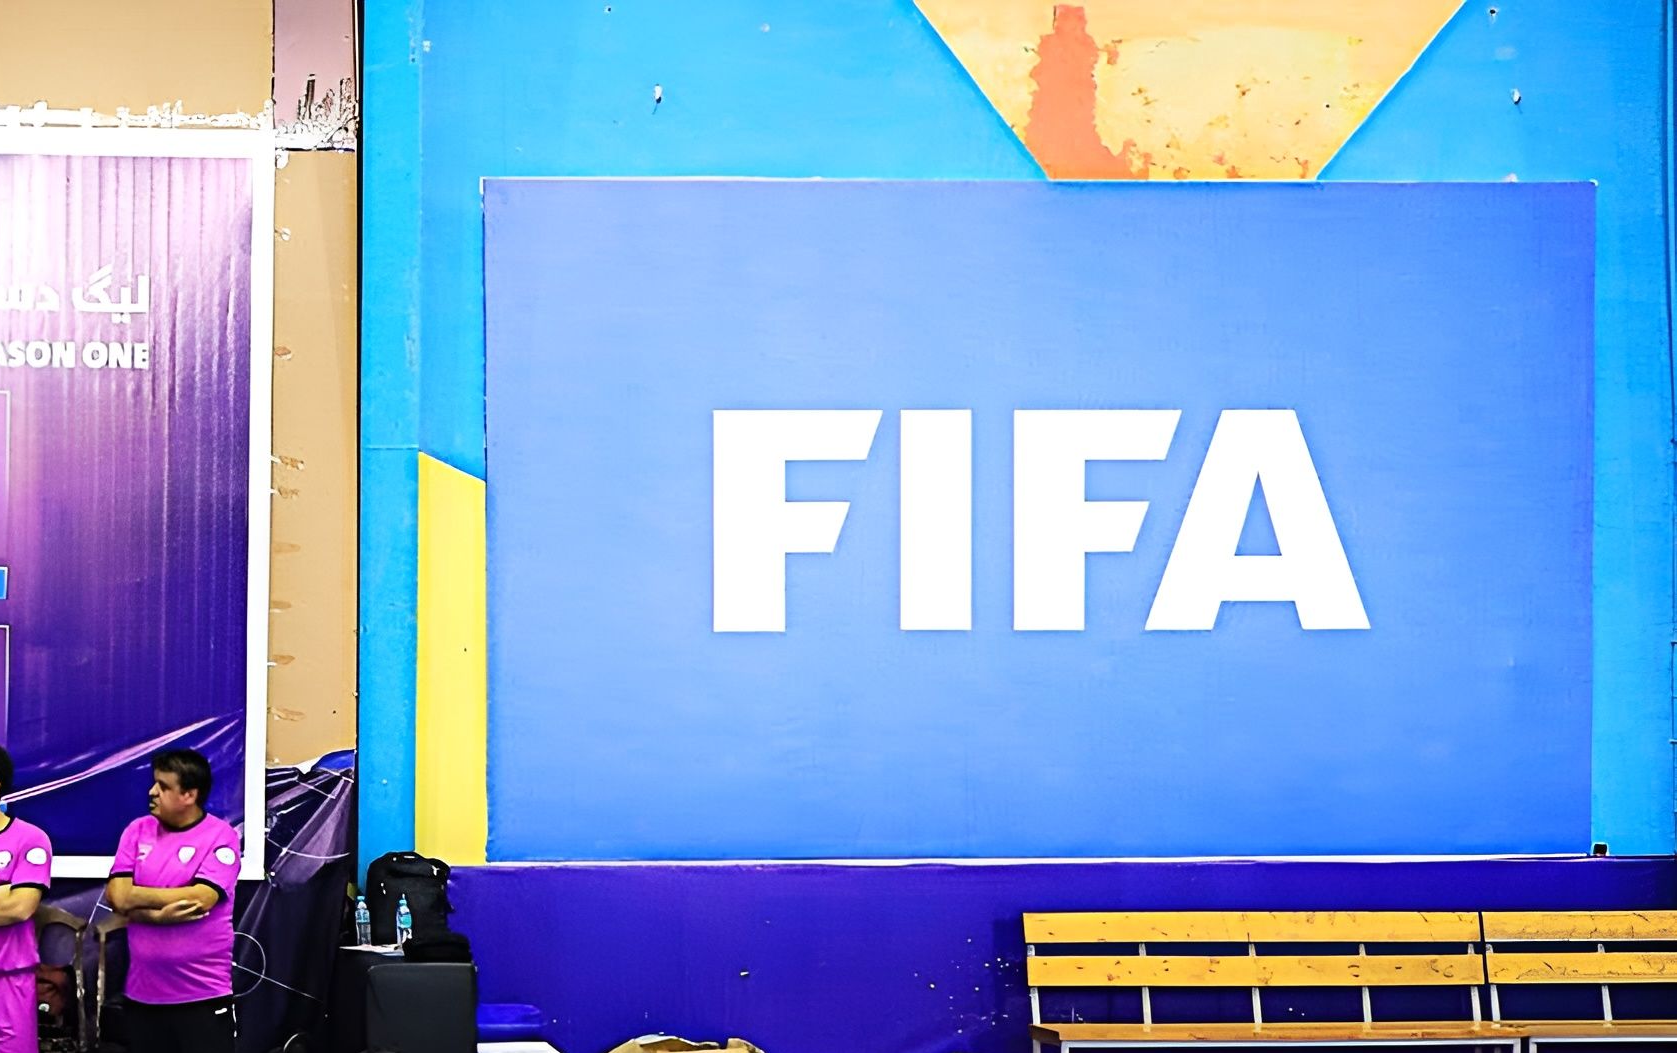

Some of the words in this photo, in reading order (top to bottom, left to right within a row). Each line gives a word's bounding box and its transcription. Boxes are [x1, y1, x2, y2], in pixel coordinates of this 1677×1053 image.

[71, 265, 150, 323] لیگ
[82, 341, 150, 370] ONE
[713, 409, 1371, 632] FIFA
